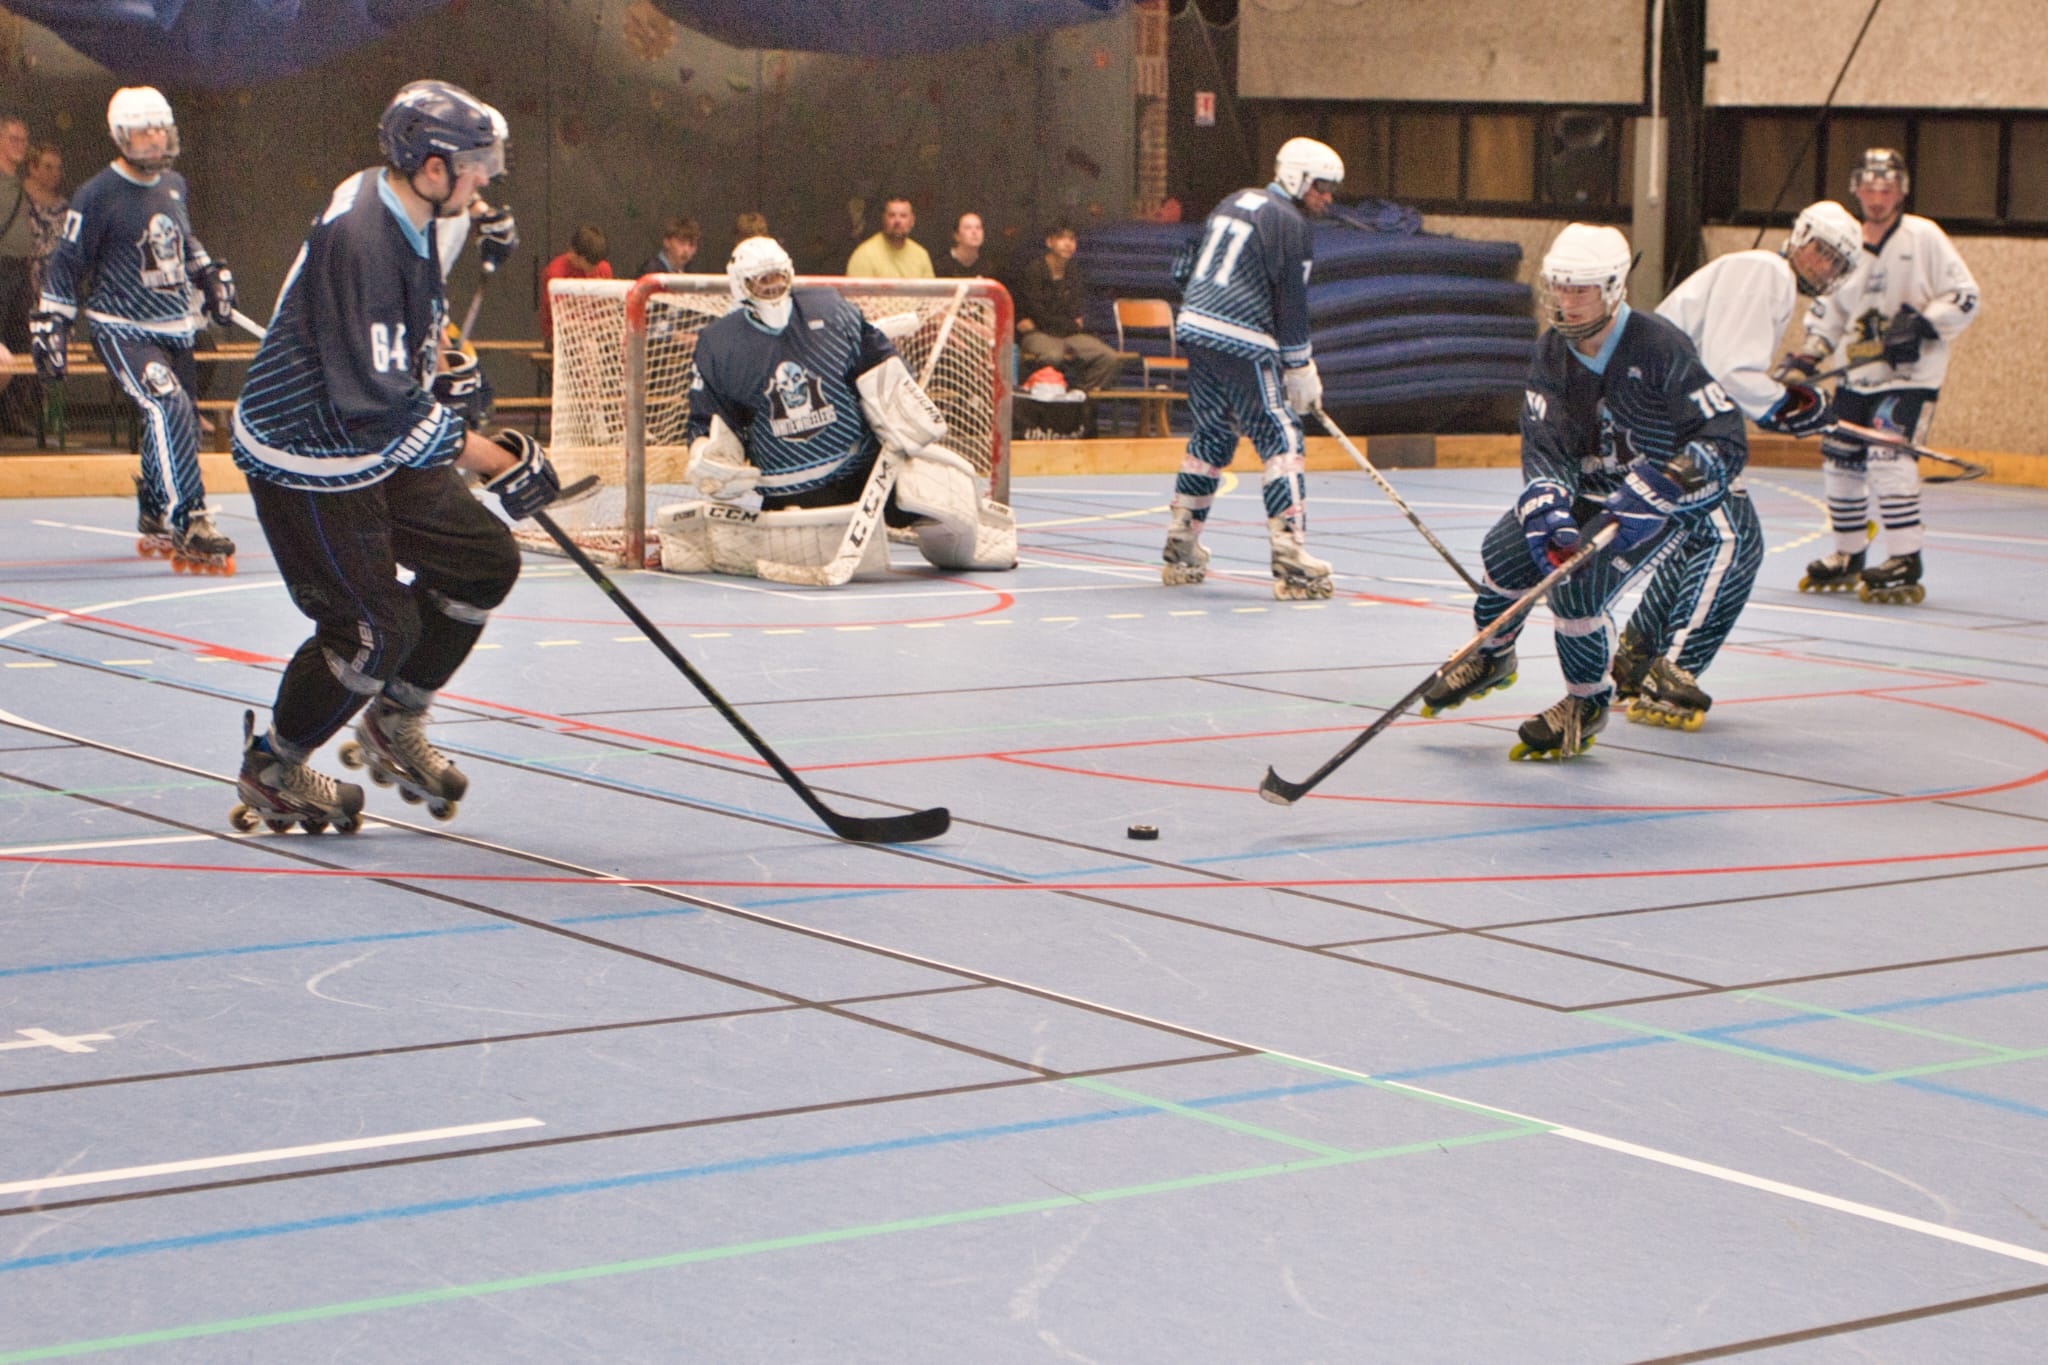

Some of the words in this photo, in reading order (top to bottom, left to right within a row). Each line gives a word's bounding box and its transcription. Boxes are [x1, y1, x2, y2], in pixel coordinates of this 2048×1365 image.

[370, 322, 408, 373] 64
[709, 507, 759, 522] CCM
[849, 460, 893, 548] CCM
[1625, 471, 1674, 514] BAUE
